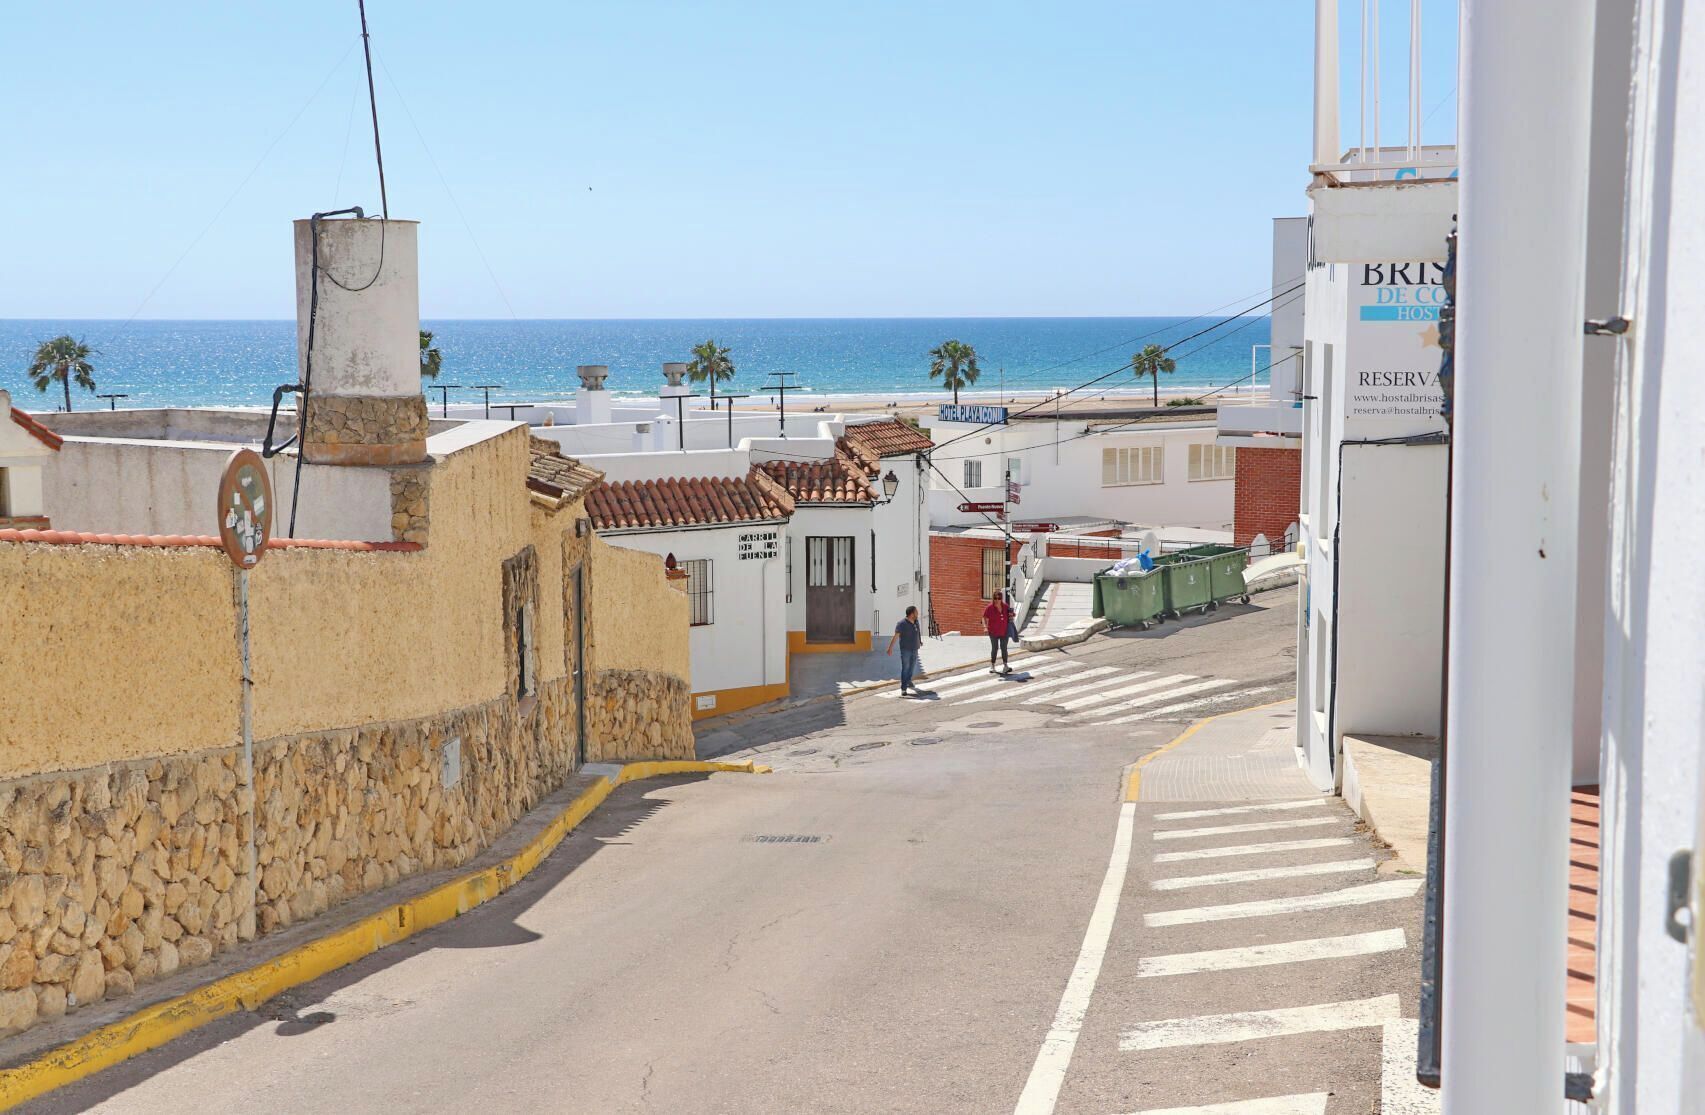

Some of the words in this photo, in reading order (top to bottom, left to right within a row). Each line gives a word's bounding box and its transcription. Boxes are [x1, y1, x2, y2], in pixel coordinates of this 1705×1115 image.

[1376, 286, 1407, 304] DE
[1415, 286, 1449, 304] CO
[1358, 371, 1441, 387] RESERVA
[940, 403, 959, 421] HOTEL
[960, 405, 982, 423] PLAYA
